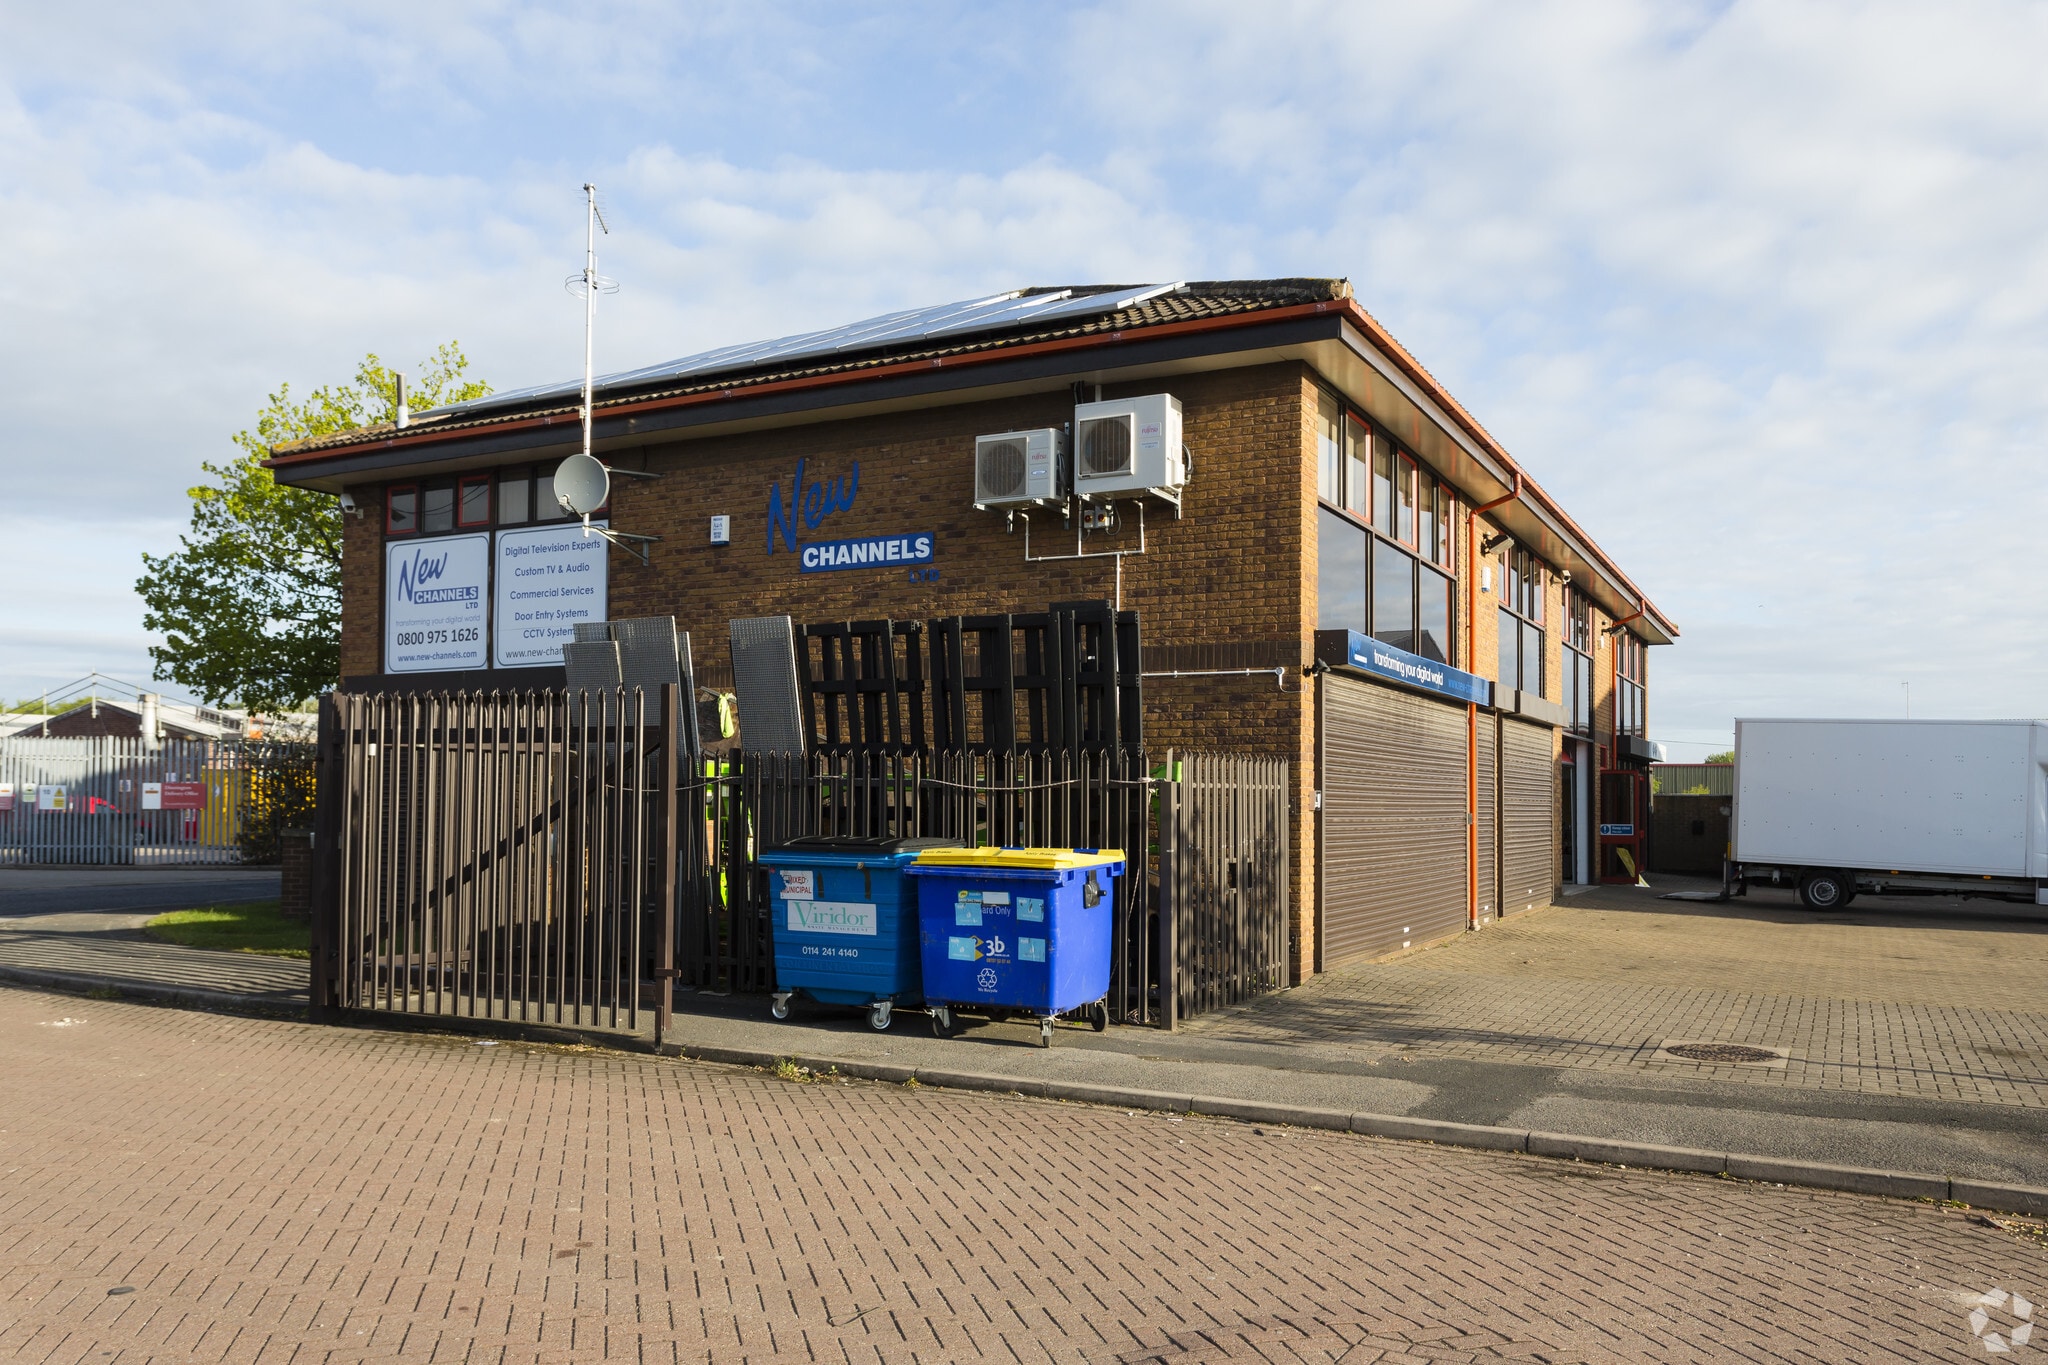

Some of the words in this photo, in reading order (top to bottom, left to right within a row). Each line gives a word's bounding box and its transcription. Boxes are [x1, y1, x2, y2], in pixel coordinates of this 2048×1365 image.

[767, 457, 859, 556] New
[505, 545, 530, 557] Digital
[531, 542, 570, 554] Television
[571, 540, 601, 552] Experts
[803, 537, 931, 568] CHANNELS
[398, 548, 448, 602] New
[514, 566, 545, 577] Custom
[546, 565, 556, 574] TV
[557, 564, 564, 574] &
[566, 562, 590, 573] Audio
[909, 568, 940, 583] LTD
[415, 587, 478, 604] CHANNELS
[510, 587, 559, 600] Commercial
[560, 586, 594, 597] Services
[395, 618, 431, 627] transforming
[431, 617, 444, 627] your
[445, 615, 463, 625] digital
[464, 614, 481, 622] world
[514, 612, 534, 621] Door
[535, 610, 555, 621] Entry
[556, 608, 589, 620] Systems
[397, 631, 425, 646] 0800
[427, 630, 448, 644] 975
[451, 627, 479, 642] 1626
[523, 628, 546, 639] CCTV
[547, 627, 575, 639] System
[398, 650, 478, 662] www.new-channels.com
[1373, 649, 1405, 678] transforming
[1405, 663, 1416, 678] your
[1416, 664, 1431, 684] digital
[1431, 671, 1444, 686] world
[793, 901, 869, 928] Viridor
[981, 905, 994, 915] ard
[995, 905, 1011, 918] Only
[802, 946, 820, 956] 0114
[822, 947, 836, 957] 241
[838, 948, 859, 958] 4140
[985, 935, 1005, 957] 3b
